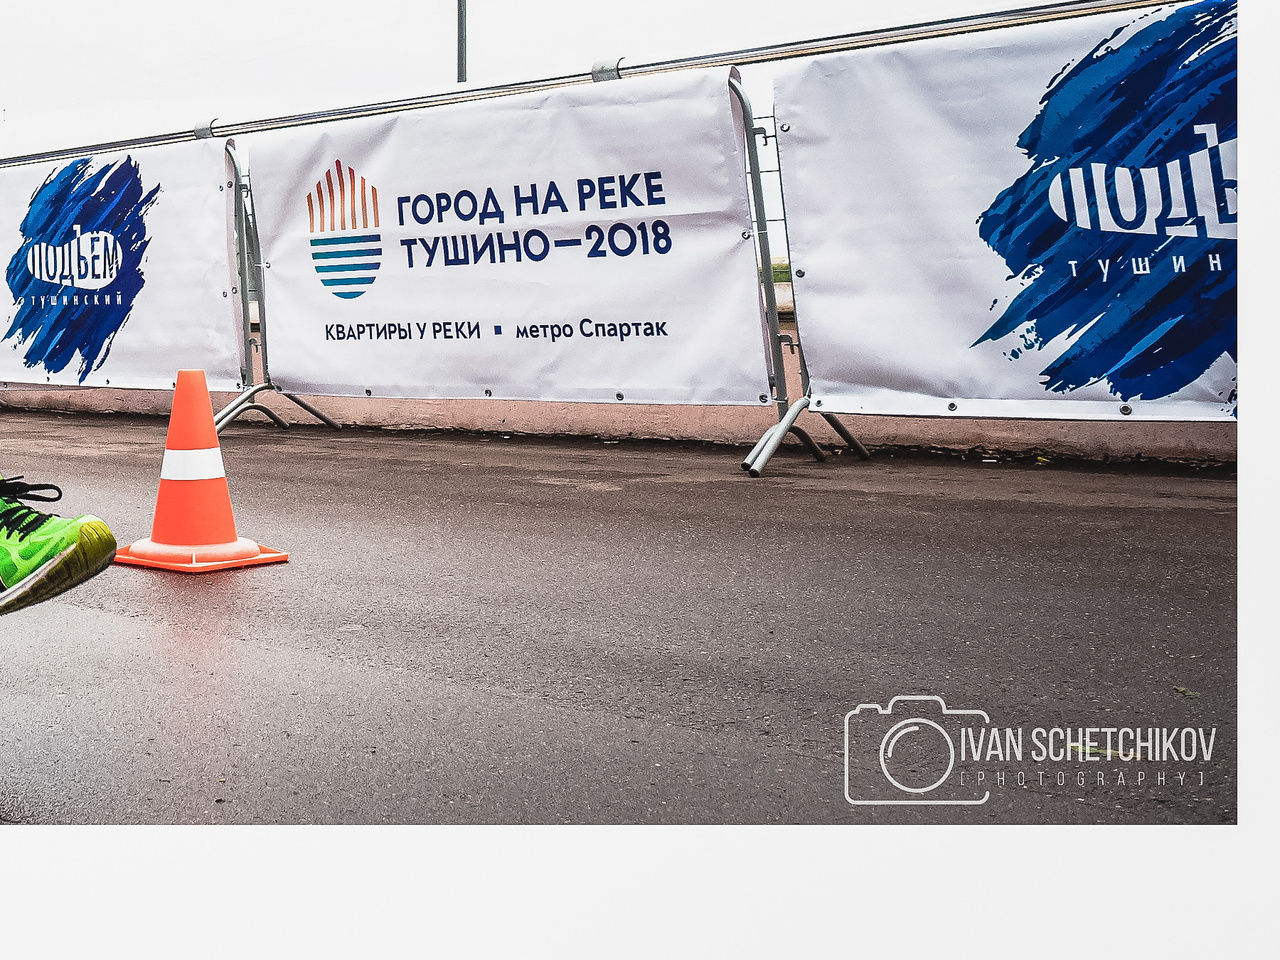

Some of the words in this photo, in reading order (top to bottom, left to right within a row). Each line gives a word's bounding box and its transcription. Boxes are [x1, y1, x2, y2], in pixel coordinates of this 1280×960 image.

[397, 187, 505, 226] ГОРОД
[513, 180, 569, 217] НА
[576, 171, 666, 211] РЕКЕ
[325, 321, 412, 341] КВАРТИРЫ
[416, 321, 429, 341] У
[432, 320, 482, 340] РЕКИ
[516, 323, 574, 343] метро
[579, 318, 668, 343] Спартак
